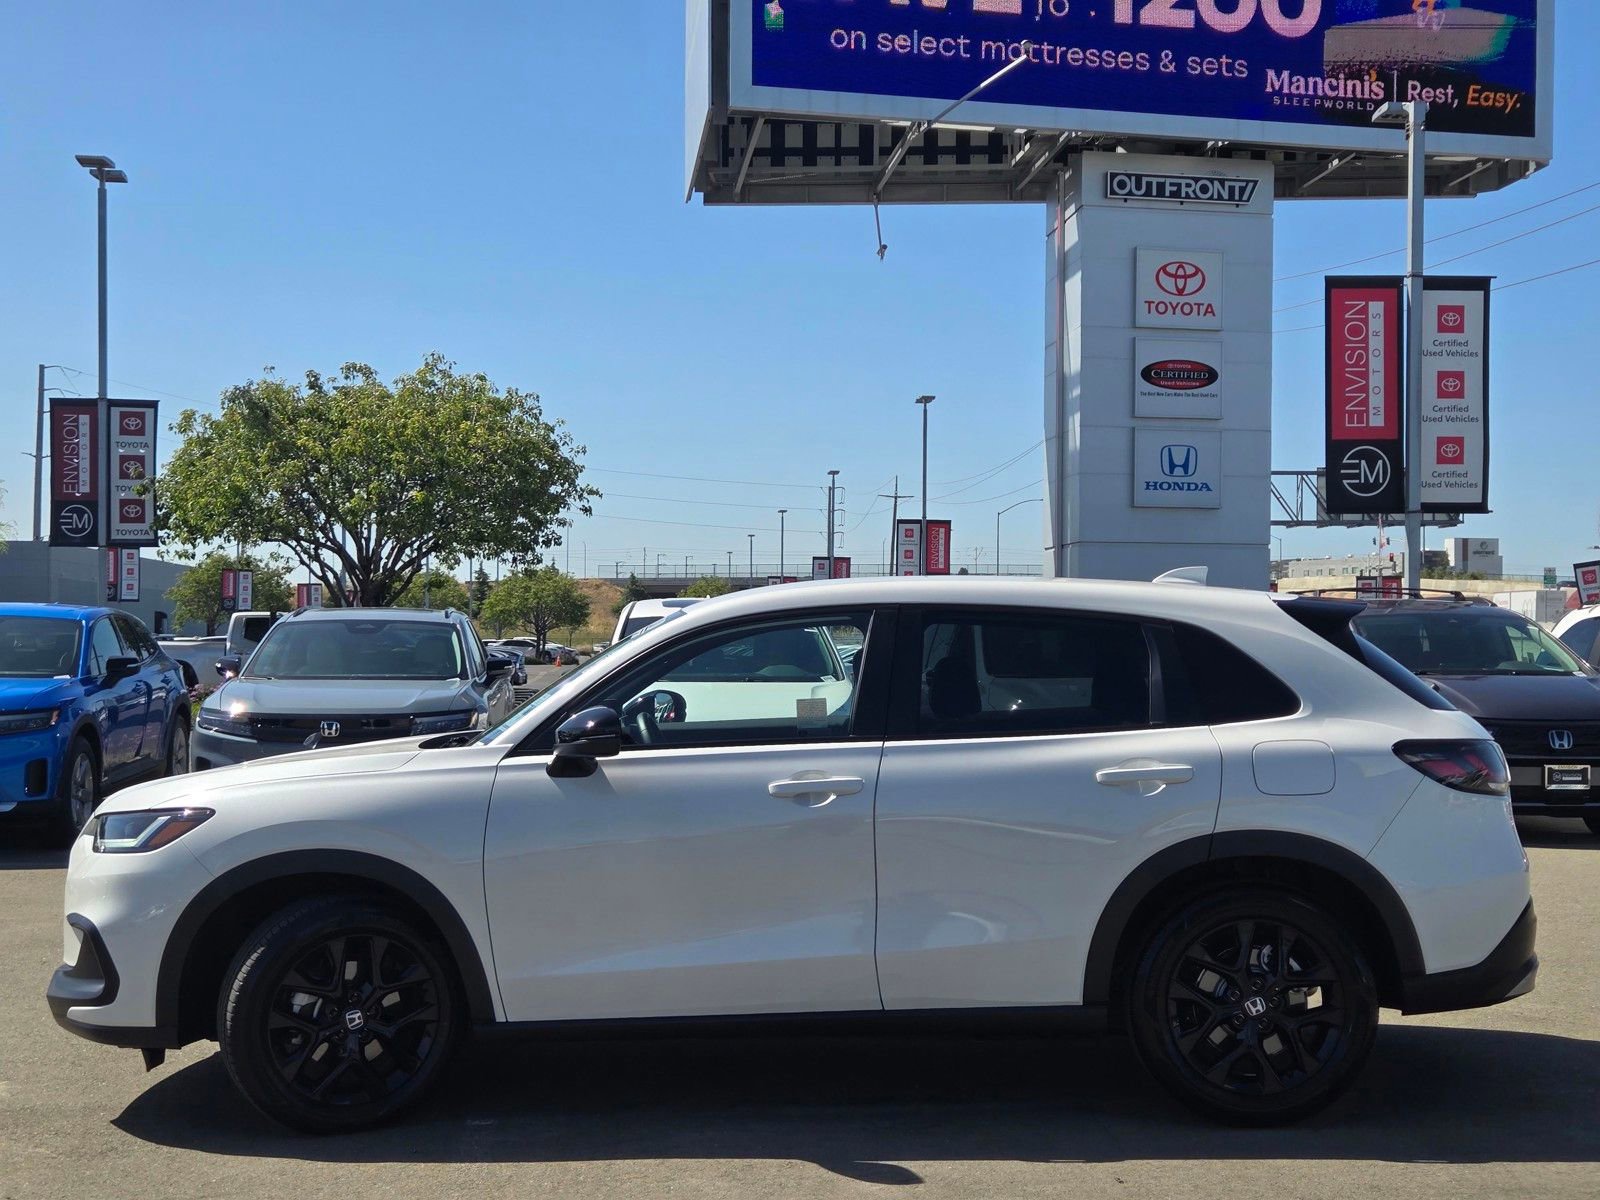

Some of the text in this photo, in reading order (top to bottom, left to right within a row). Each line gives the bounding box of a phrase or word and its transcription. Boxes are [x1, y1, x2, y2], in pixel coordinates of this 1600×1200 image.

[829, 28, 1249, 78] on select mattresses & sets
[1273, 95, 1375, 112] SLEEPWORLD
[1144, 300, 1216, 317] TOYOTA
[1433, 339, 1469, 348] Certified
[1422, 350, 1479, 358] Used Vehicles
[1344, 300, 1367, 427] ENVISION
[1372, 312, 1382, 417] MOTORS
[1433, 405, 1469, 414] Certified
[1422, 415, 1479, 424] Used Vehicles
[115, 441, 150, 449] TOYOTA
[63, 414, 78, 493] ENVISION
[1432, 470, 1468, 480] Certified
[1144, 480, 1213, 492] HONDA
[1421, 481, 1478, 490] Used Vehicles
